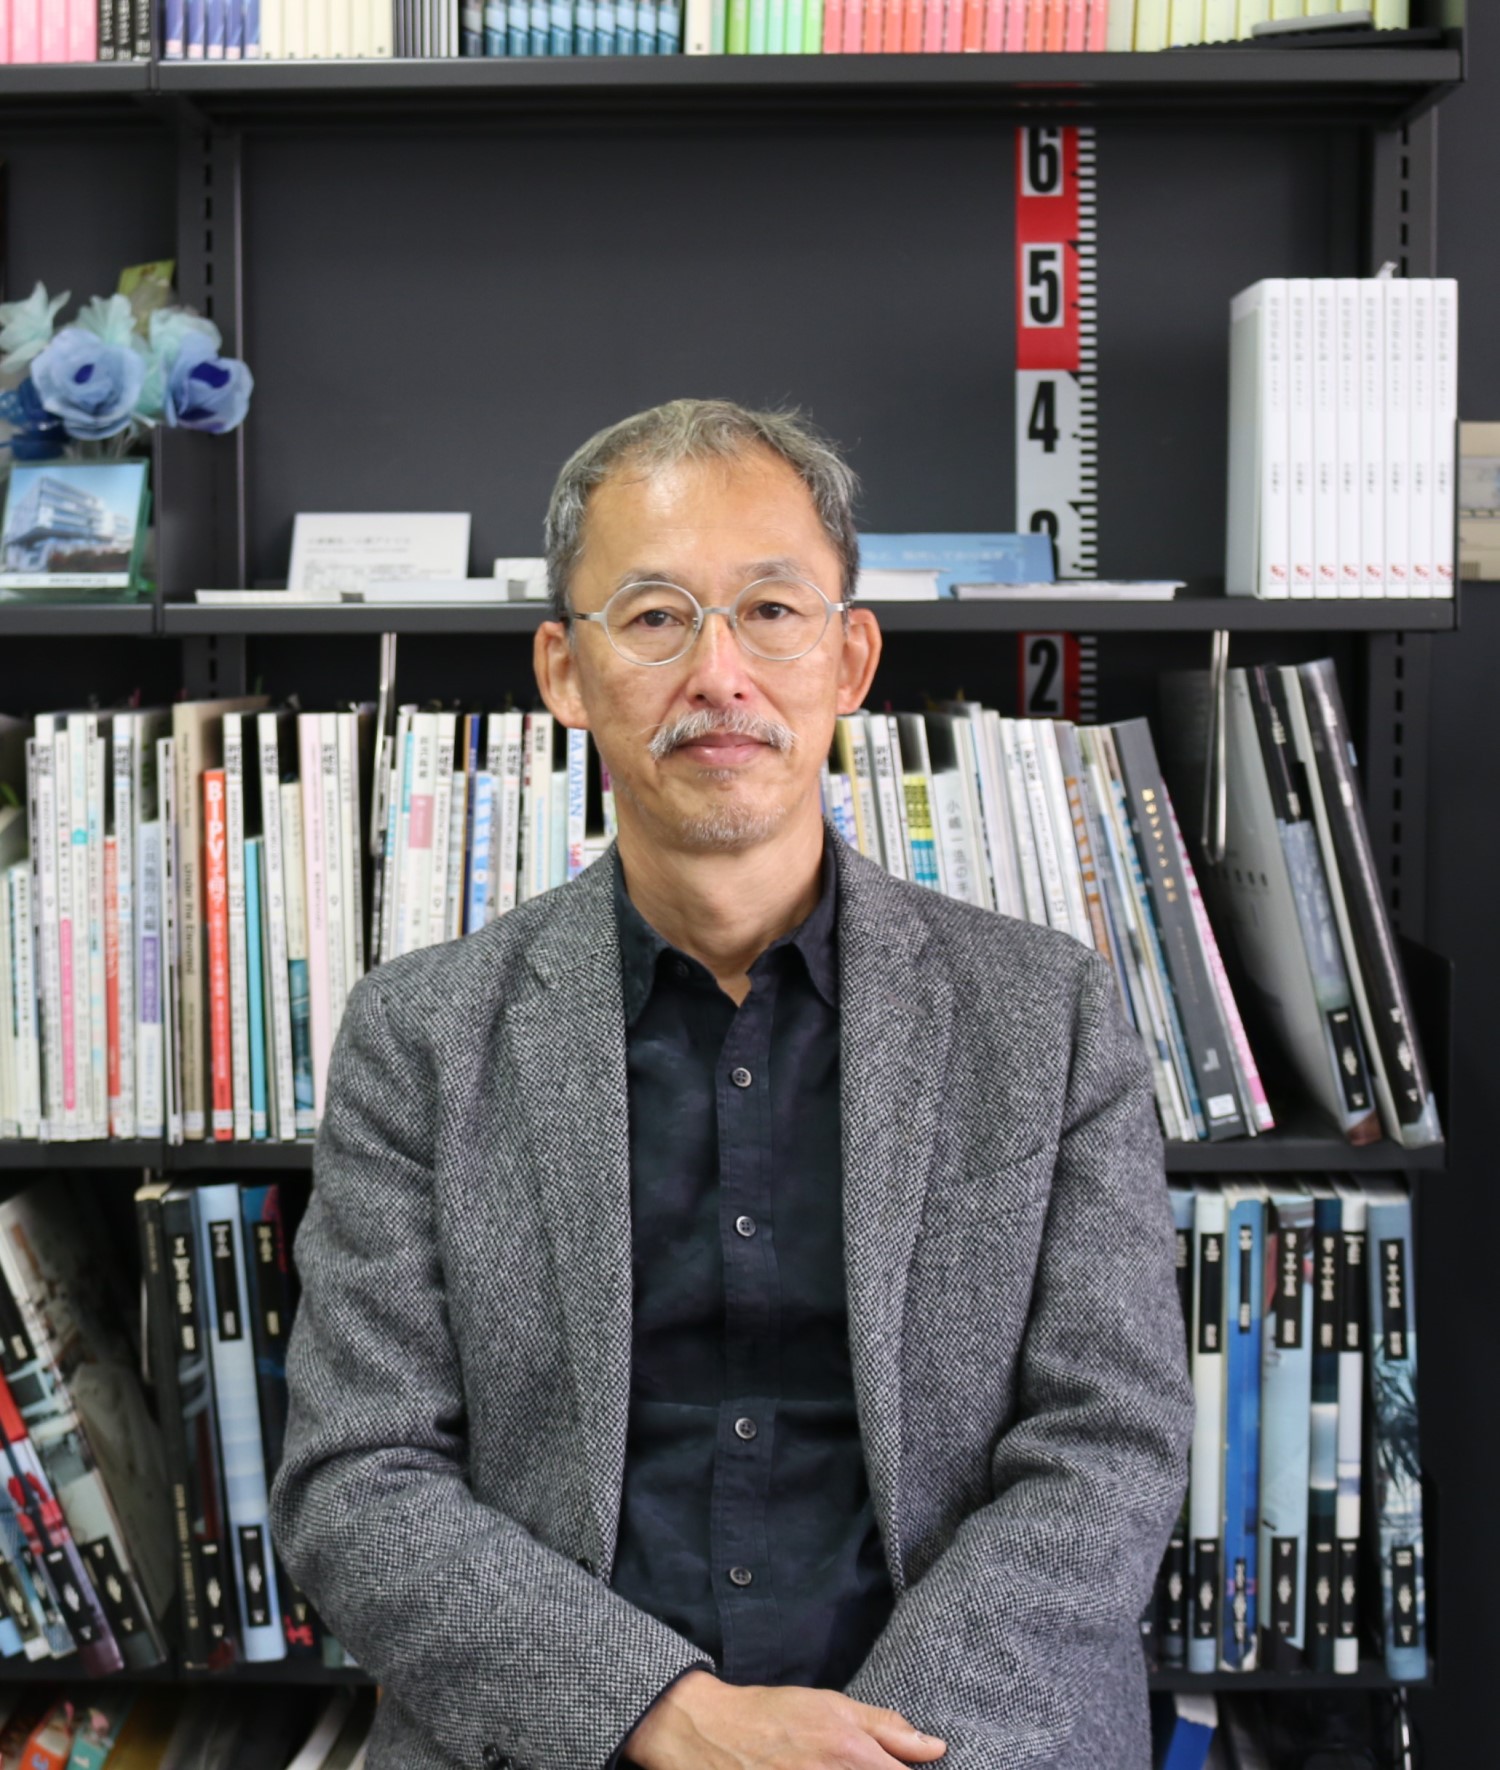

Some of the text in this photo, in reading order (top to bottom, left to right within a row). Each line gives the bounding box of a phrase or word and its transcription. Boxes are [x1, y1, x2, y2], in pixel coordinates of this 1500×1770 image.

[1028, 125, 1058, 193] 6
[1029, 249, 1060, 325] 5
[1028, 380, 1060, 454] 4
[1028, 638, 1059, 714] 2
[570, 758, 583, 817] JAPAN
